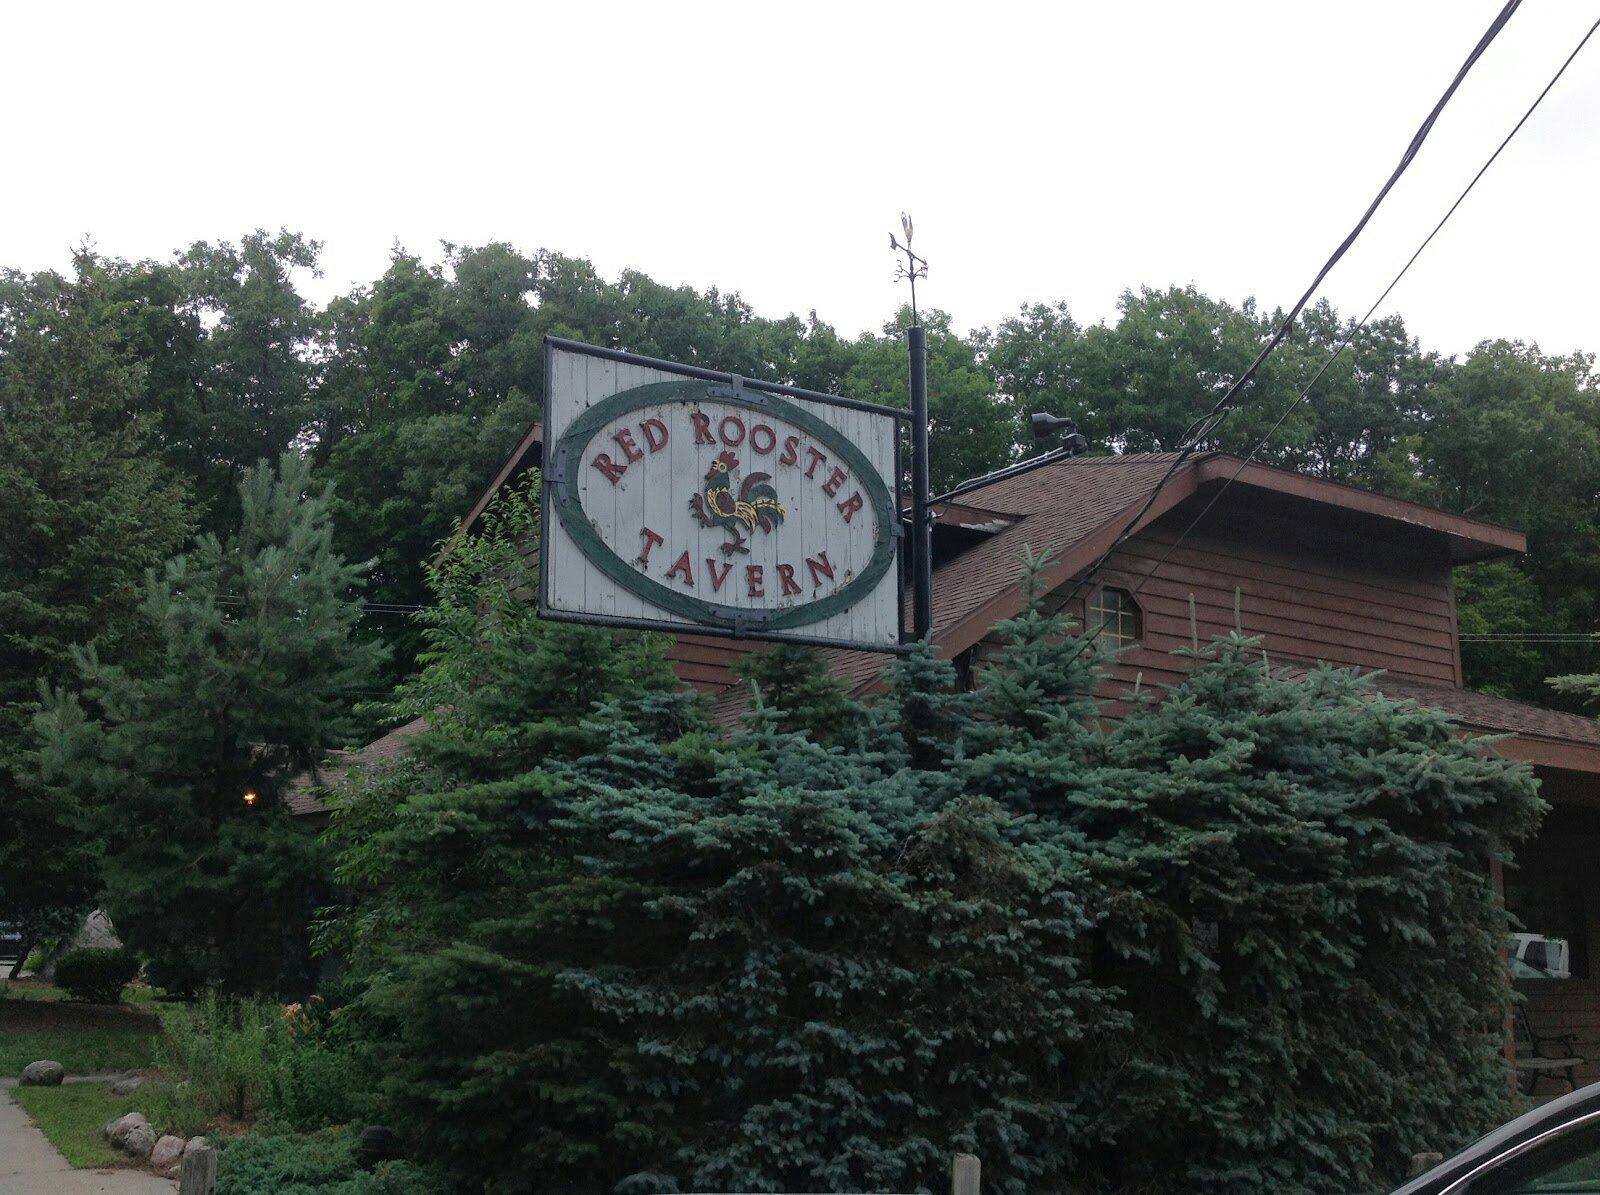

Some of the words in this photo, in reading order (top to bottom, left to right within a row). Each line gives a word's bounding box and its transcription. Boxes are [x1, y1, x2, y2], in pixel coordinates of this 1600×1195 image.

[592, 418, 669, 486] RED
[691, 411, 865, 523] ROOSTER
[638, 527, 835, 598] TAVERN
